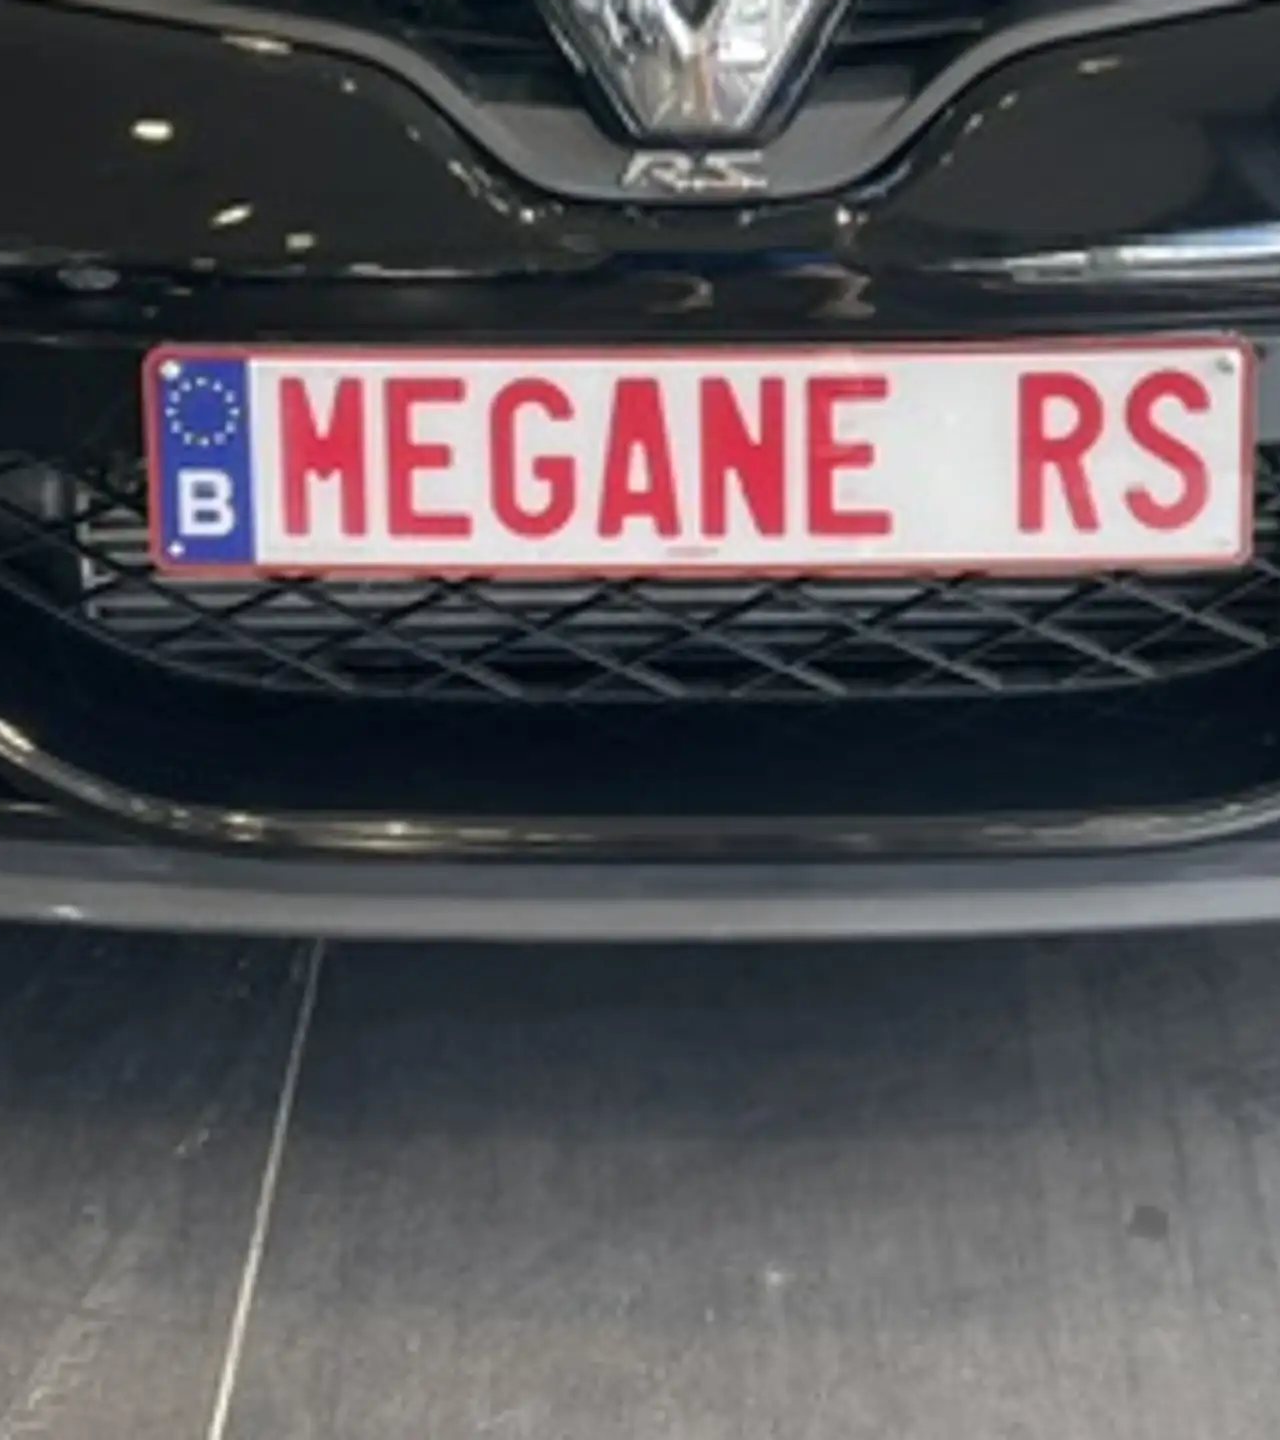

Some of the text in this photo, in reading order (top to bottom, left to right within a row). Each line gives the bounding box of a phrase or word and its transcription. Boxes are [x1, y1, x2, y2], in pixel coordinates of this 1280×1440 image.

[178, 469, 235, 535] B
[277, 371, 1211, 539] MEGANE RS
